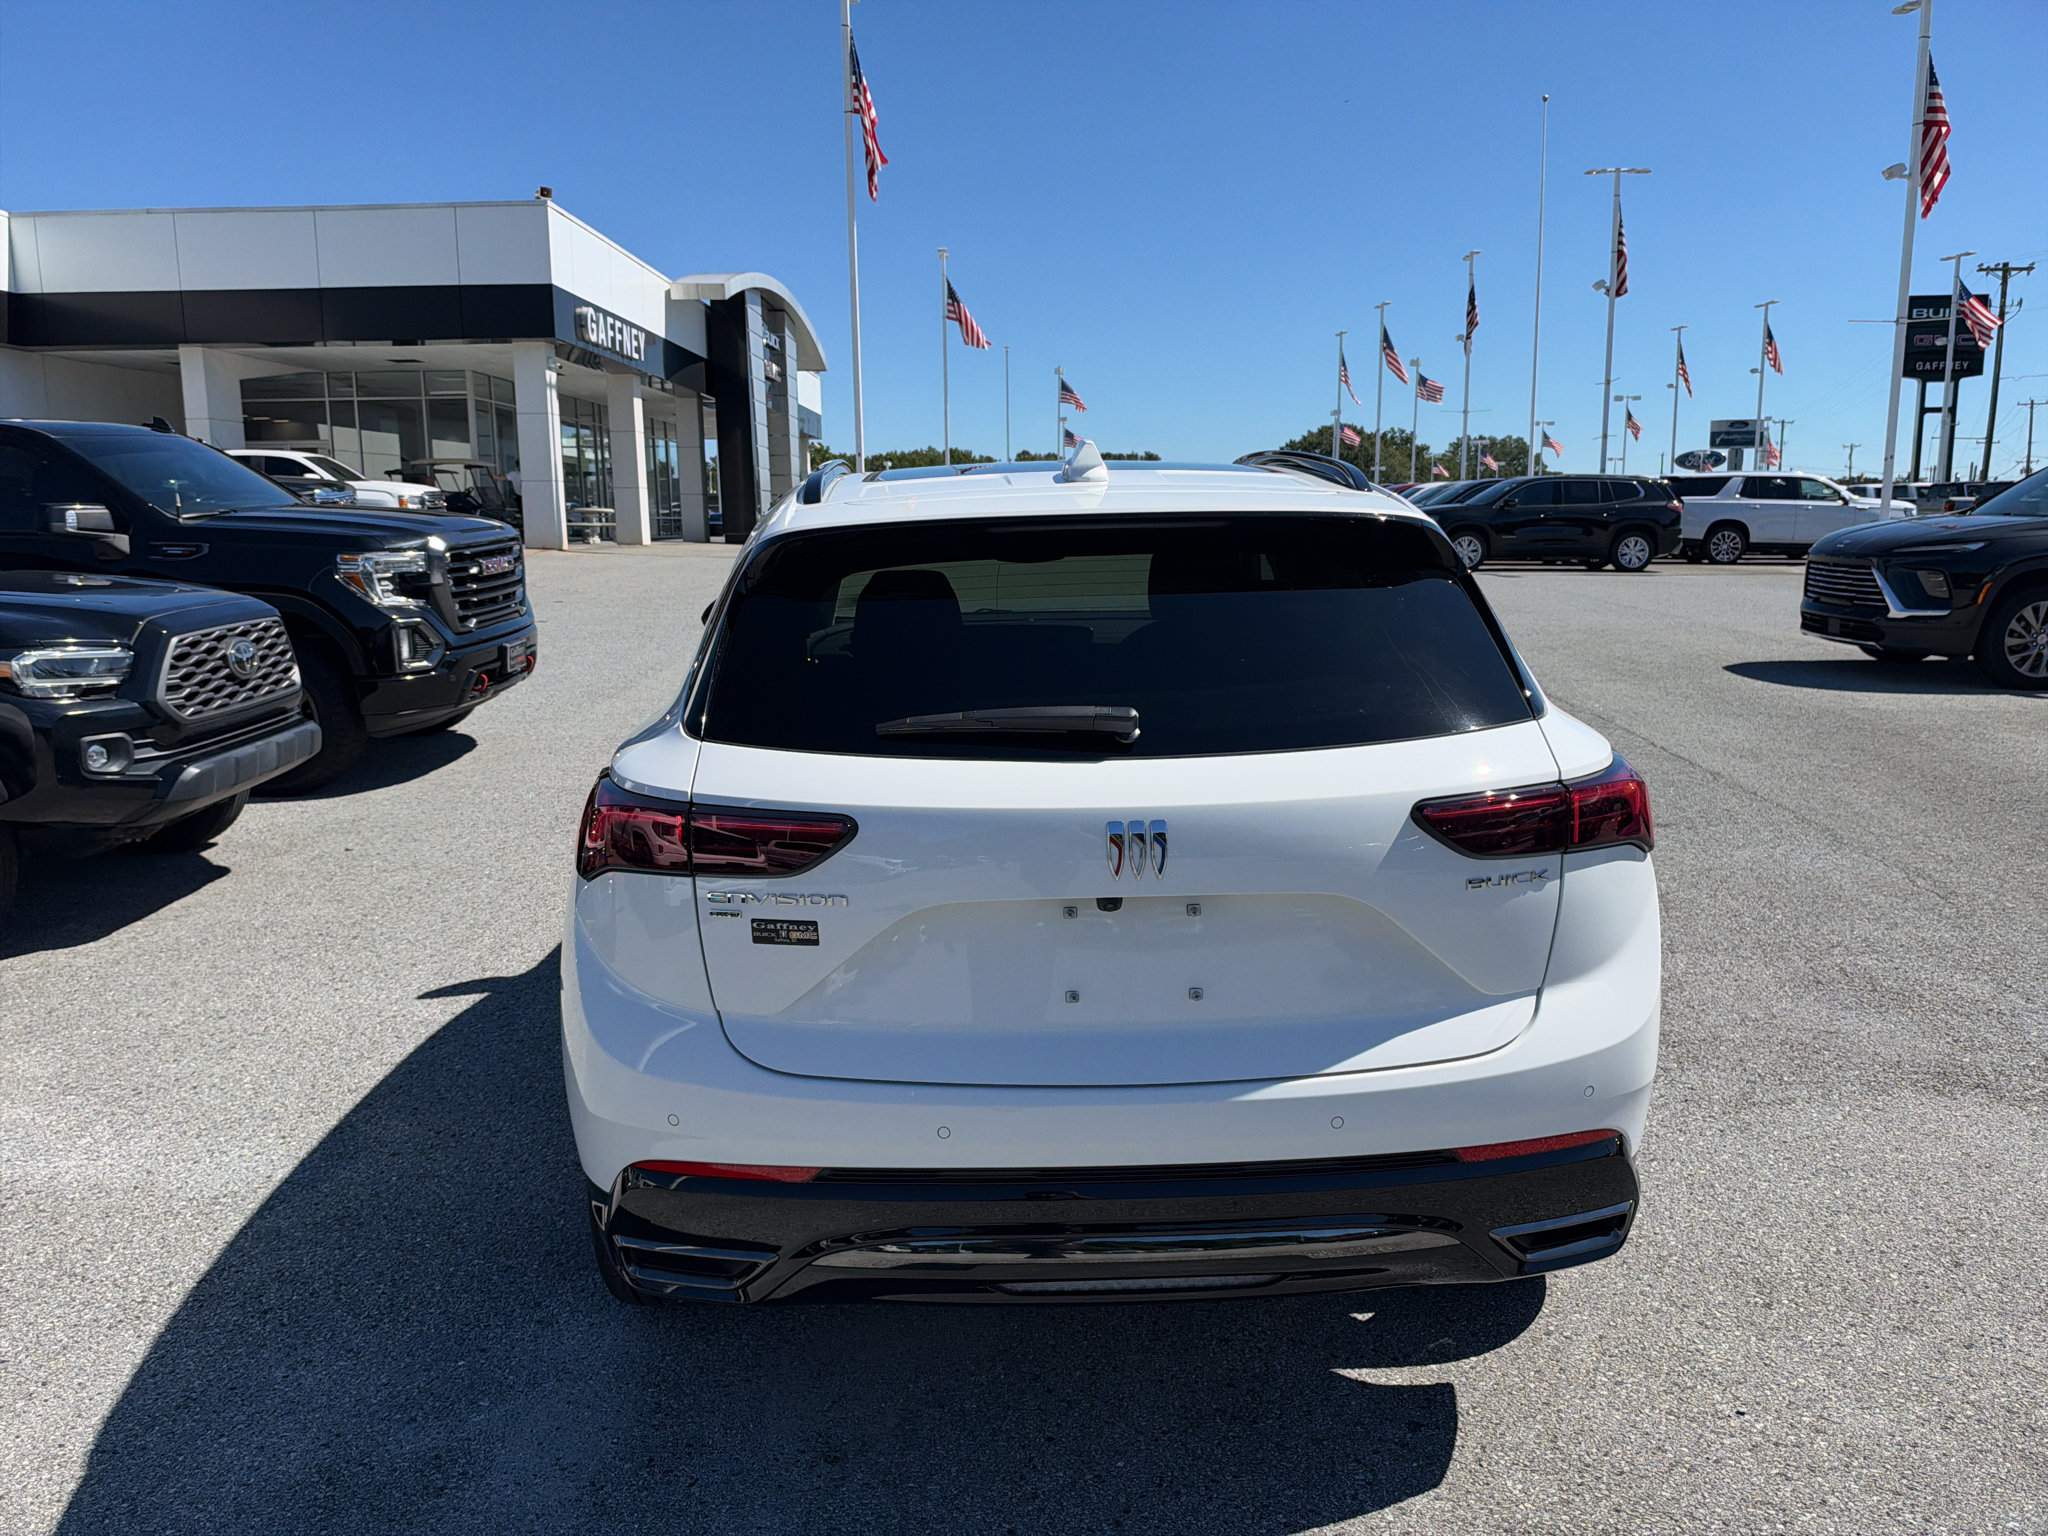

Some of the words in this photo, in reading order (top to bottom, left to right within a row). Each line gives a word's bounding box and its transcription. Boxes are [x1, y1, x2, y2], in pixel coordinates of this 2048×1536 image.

[586, 307, 646, 361] GAFFNEY
[1915, 361, 1970, 371] GAFFEY
[482, 555, 514, 576] GMC
[1465, 868, 1550, 891] BUICK
[752, 921, 817, 931] Gaffney
[789, 930, 818, 940] GMC
